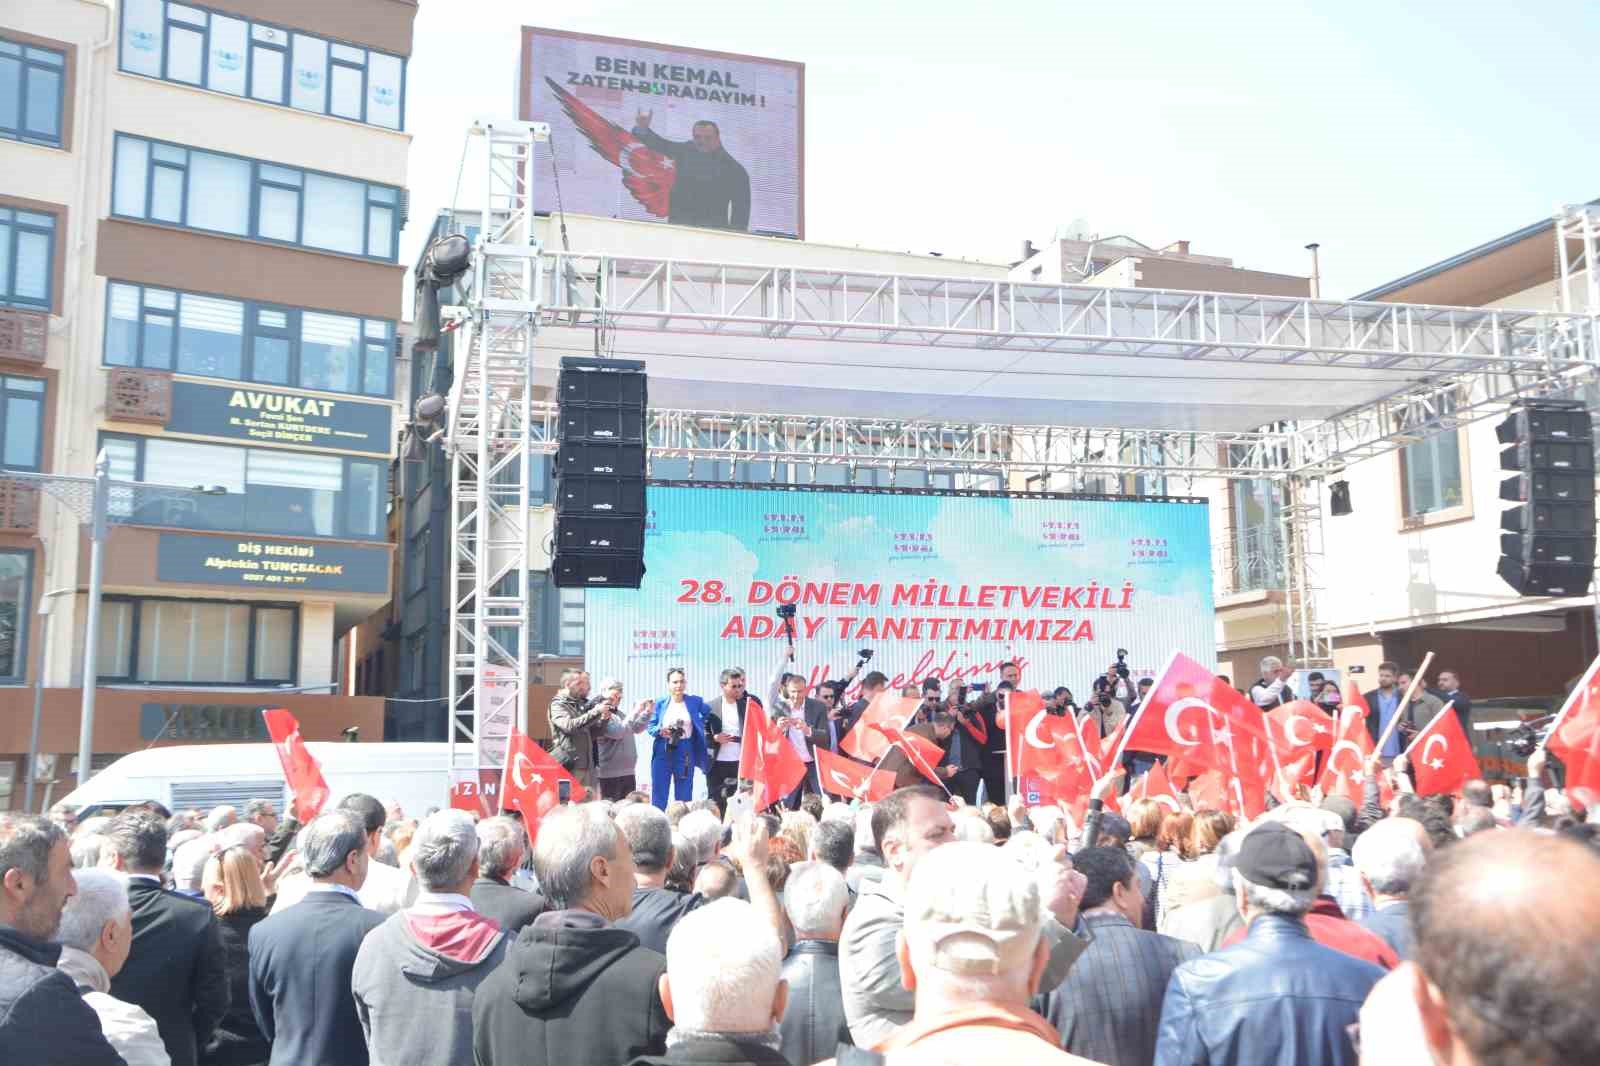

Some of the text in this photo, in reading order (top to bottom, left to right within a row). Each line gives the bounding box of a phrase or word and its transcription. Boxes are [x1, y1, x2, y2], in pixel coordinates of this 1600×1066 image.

[567, 71, 634, 93] ZATEN
[594, 55, 739, 88] BEN KEMAL
[229, 391, 335, 417] AVUKAT
[677, 575, 1134, 609] 28. DÖNEM MİLLETVEKİLİ
[720, 615, 1094, 643] ADAY TANITIMIMIZA
